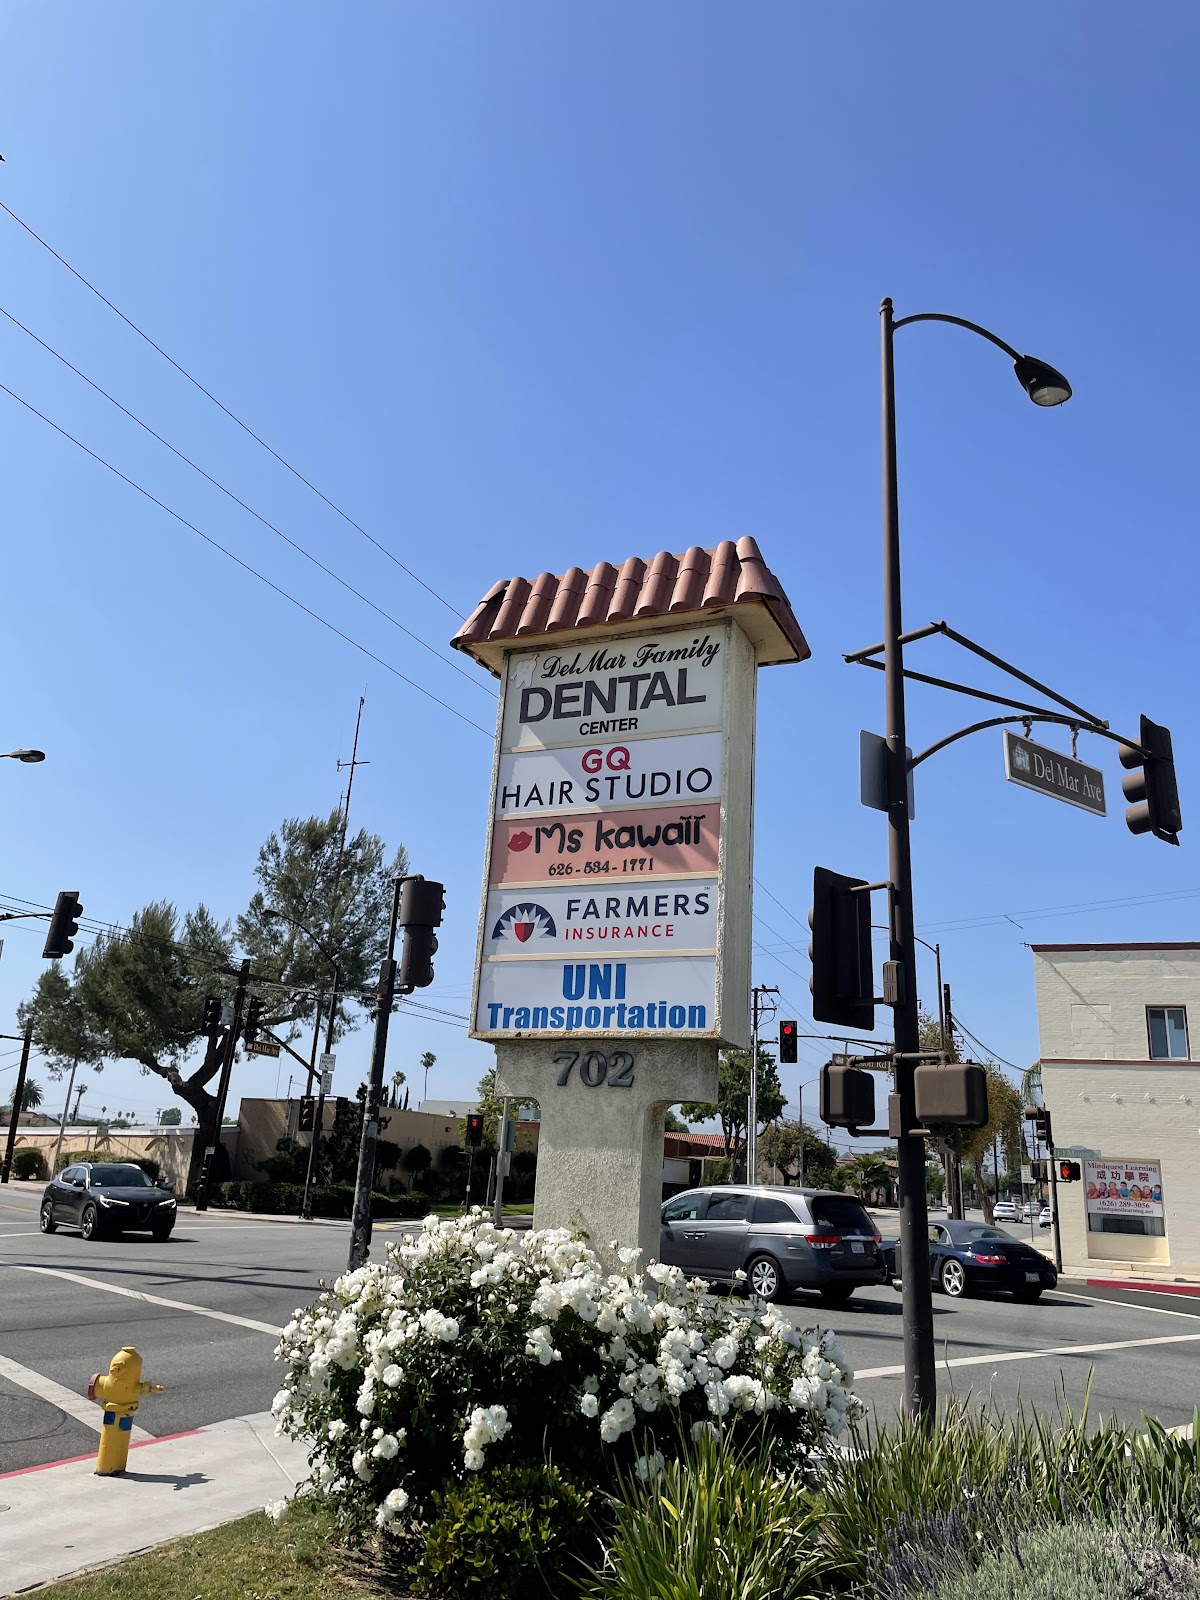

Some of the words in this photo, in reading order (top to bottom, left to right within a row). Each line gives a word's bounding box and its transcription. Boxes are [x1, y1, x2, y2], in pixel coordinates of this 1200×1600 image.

[633, 636, 720, 668] Family
[519, 668, 706, 724] DENTAL
[579, 717, 639, 736] CENTER
[581, 746, 631, 774] GQ
[501, 780, 574, 809] HAIR
[585, 767, 713, 803] STUDIO
[1033, 753, 1055, 783] Del
[1056, 763, 1079, 792] Mar
[1083, 774, 1102, 802] Ave
[535, 823, 584, 854] Ms
[595, 814, 706, 852] kawaii
[566, 893, 710, 920] FARMERS
[565, 924, 675, 940] INSURANCE
[562, 963, 627, 1000] UNI
[487, 1001, 706, 1031] Transportation
[553, 1050, 635, 1088] 702
[1087, 1162, 1124, 1171] Mindquest
[1125, 1164, 1157, 1173] Learning
